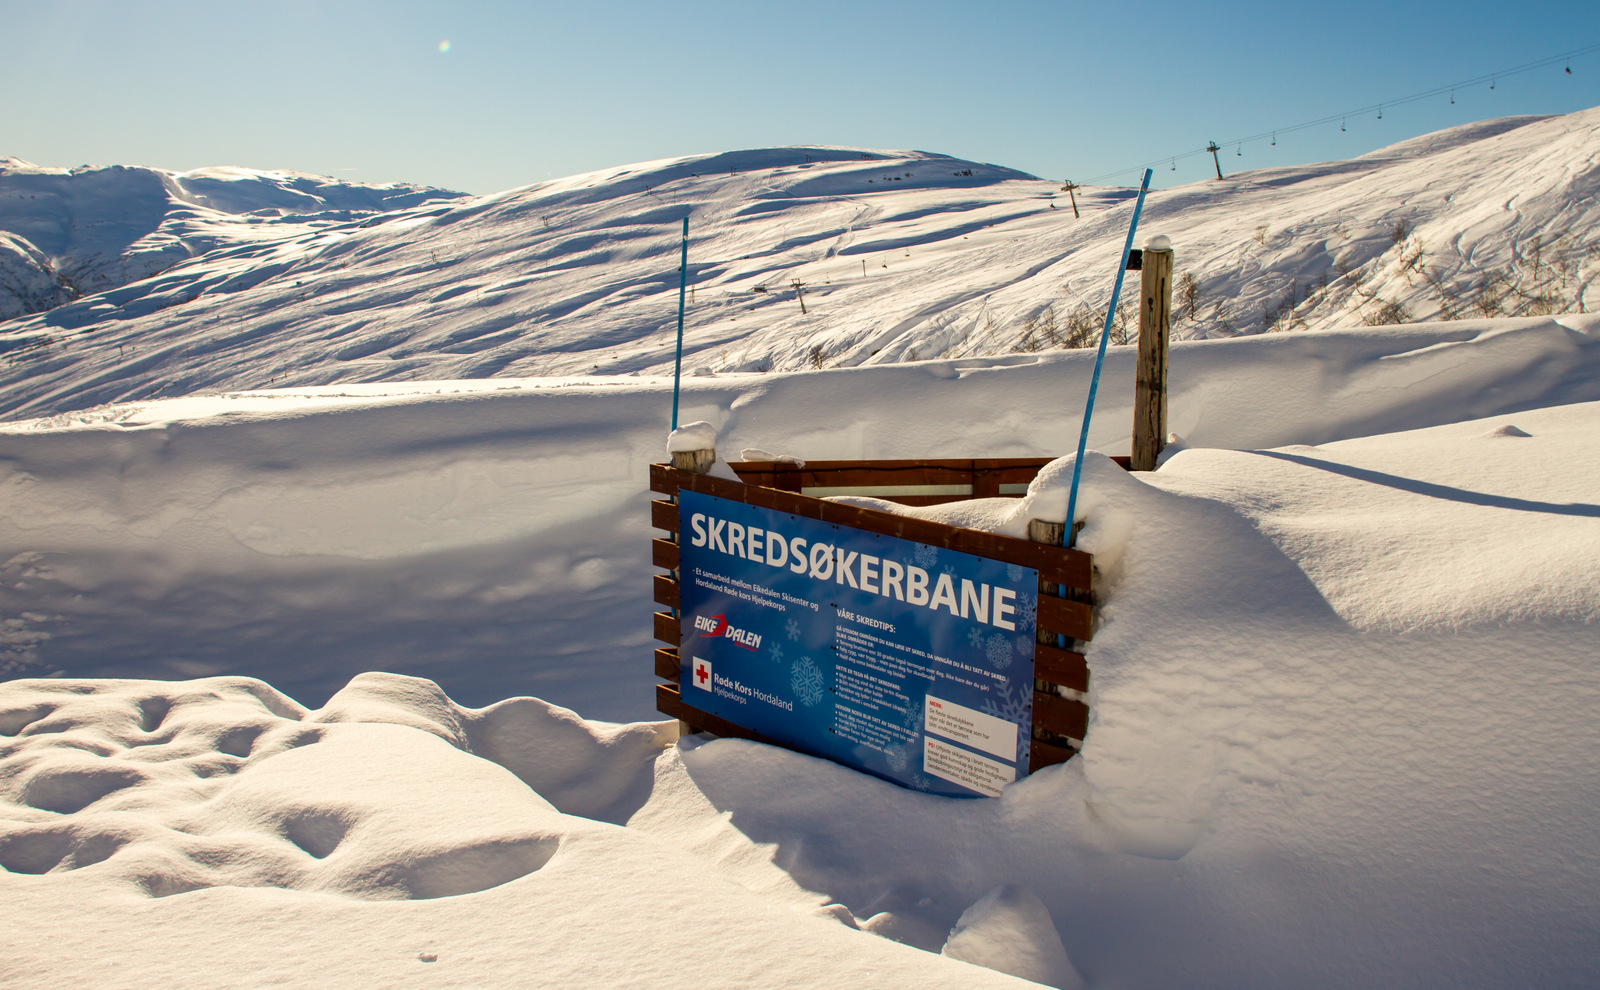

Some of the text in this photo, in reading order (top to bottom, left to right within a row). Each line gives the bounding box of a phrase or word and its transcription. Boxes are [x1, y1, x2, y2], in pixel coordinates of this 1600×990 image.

[691, 513, 1016, 631] SKREDSØKERBANE
[695, 578, 786, 612] Hordaland Røde kors Hjelpekorps
[696, 568, 819, 612] Et samarbeid mellom Eikedalen Skisenter og
[694, 615, 762, 648] EIKE DALEN
[837, 608, 896, 633] VÅRE SKREDTIPS:
[934, 655, 952, 665] UNNGÅR
[714, 673, 793, 711] Røde Kors Hordaland
[714, 686, 747, 705] Hjelpekorps
